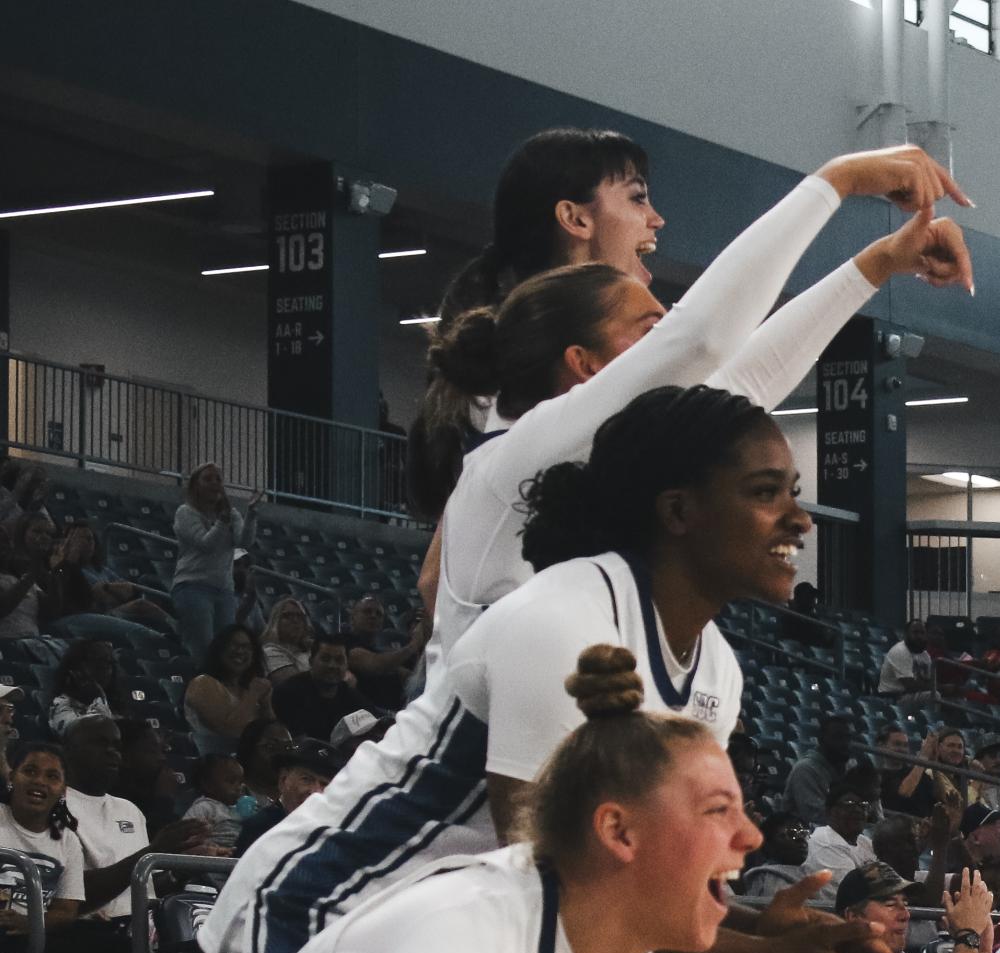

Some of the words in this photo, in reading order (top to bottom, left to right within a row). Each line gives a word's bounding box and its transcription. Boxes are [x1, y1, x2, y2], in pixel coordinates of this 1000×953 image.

[274, 212, 326, 231] SECTION
[276, 232, 325, 273] 103
[275, 296, 324, 313] SEATING
[823, 360, 868, 376] SECTION
[823, 378, 868, 411] 104
[825, 430, 866, 445] SEATING
